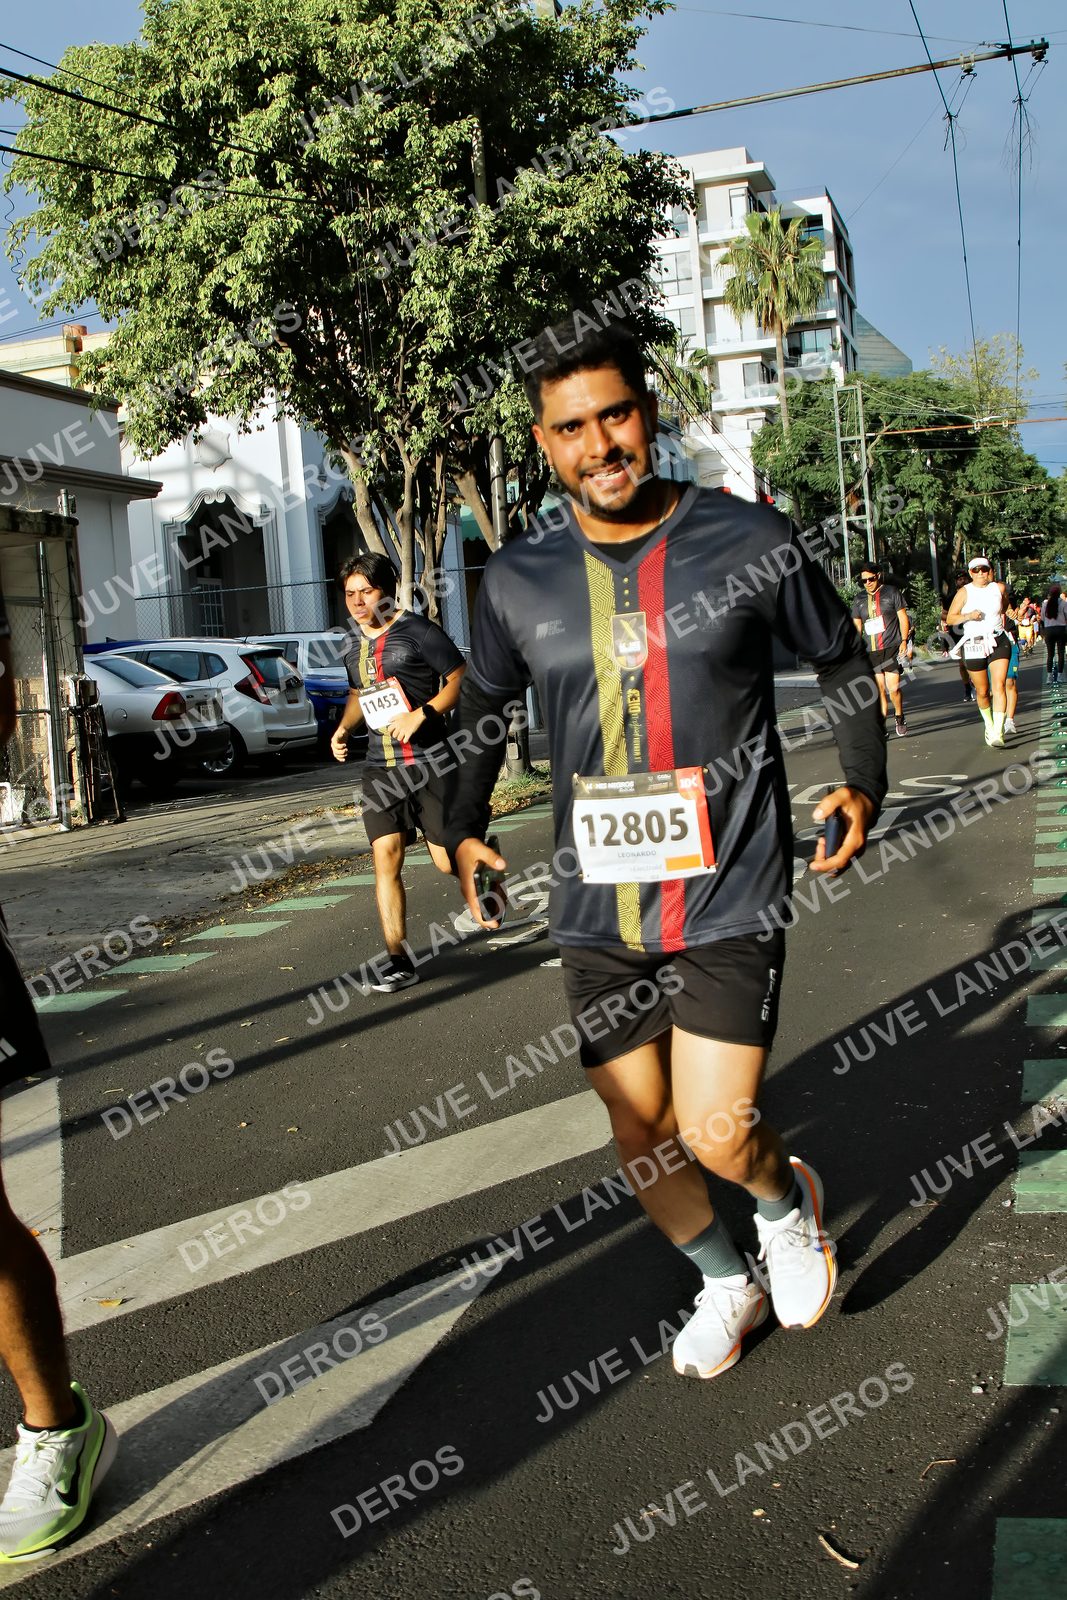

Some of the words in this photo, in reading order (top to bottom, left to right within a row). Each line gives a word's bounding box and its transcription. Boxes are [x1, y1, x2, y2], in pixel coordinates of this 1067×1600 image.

[362, 693, 399, 714] 11453
[580, 806, 689, 848] 12805
[617, 850, 657, 858] LEONARDO
